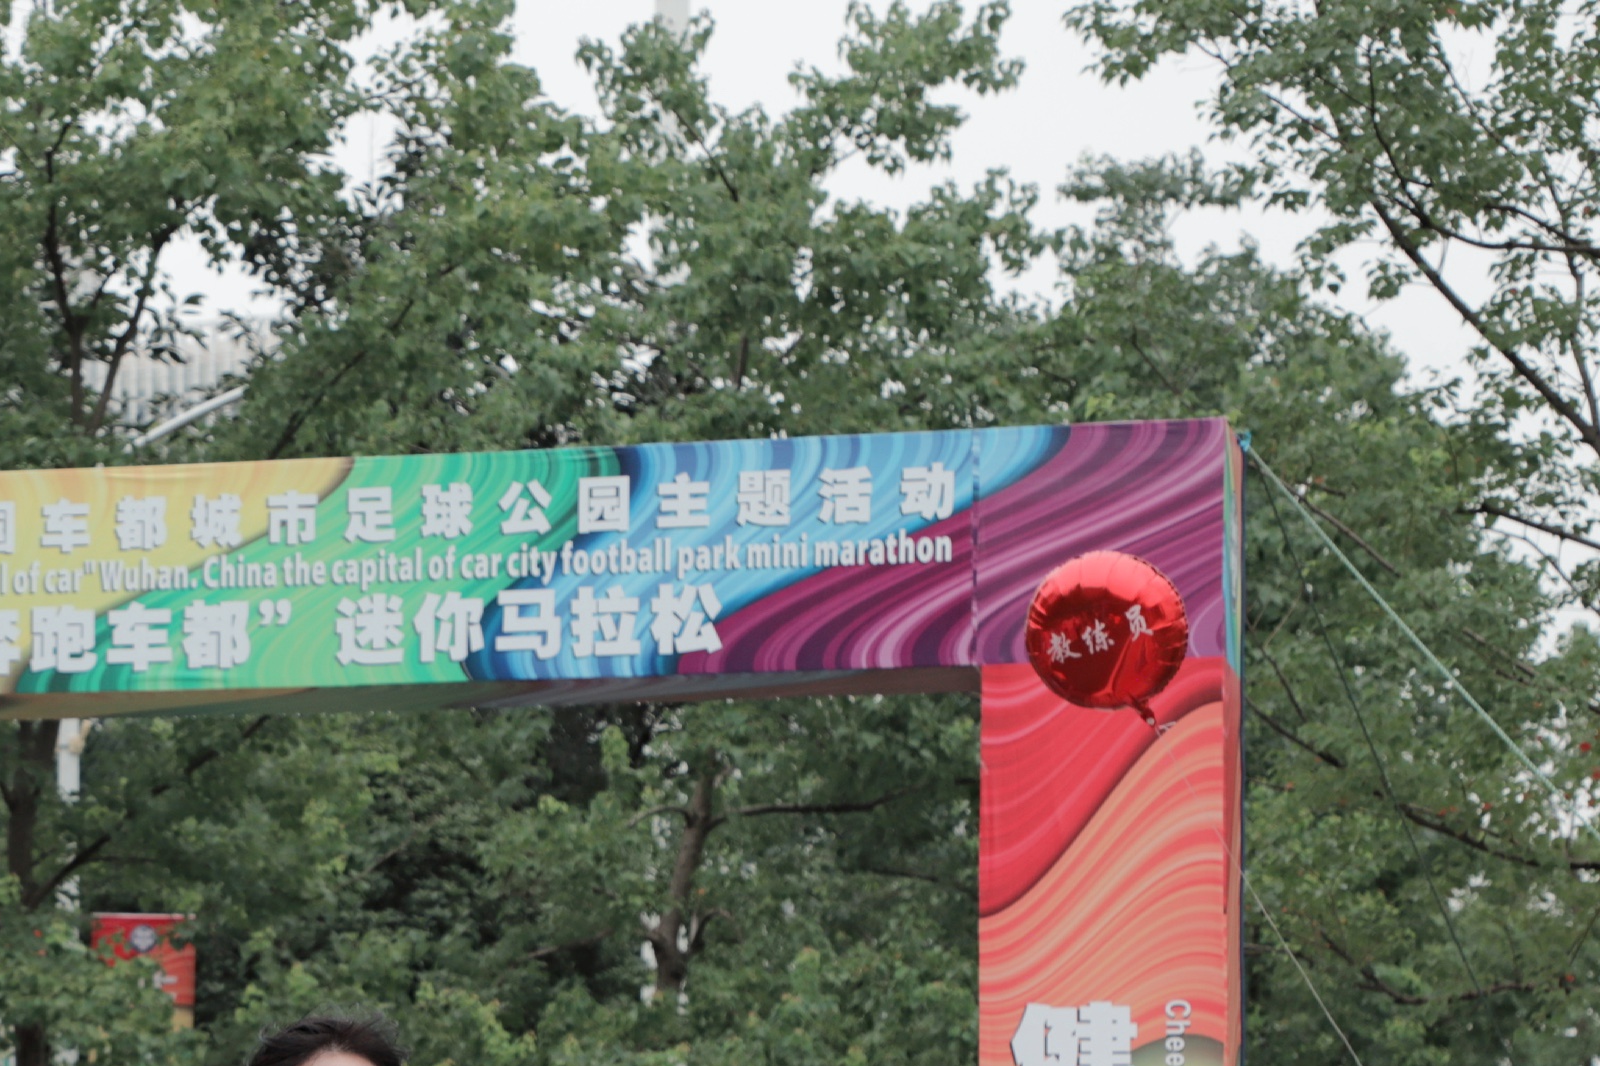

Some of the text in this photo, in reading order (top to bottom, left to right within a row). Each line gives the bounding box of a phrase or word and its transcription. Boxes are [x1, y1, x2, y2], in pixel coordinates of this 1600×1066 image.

[14, 560, 41, 594] of
[203, 554, 277, 588] China
[283, 552, 326, 585] the
[331, 547, 422, 591] capital
[429, 546, 456, 580] of
[461, 554, 502, 579] car
[507, 543, 556, 584] city
[562, 537, 672, 575] football
[678, 535, 741, 579] park
[748, 532, 808, 568] mini
[815, 529, 953, 566] marathon
[1047, 604, 1154, 664] 教练员
